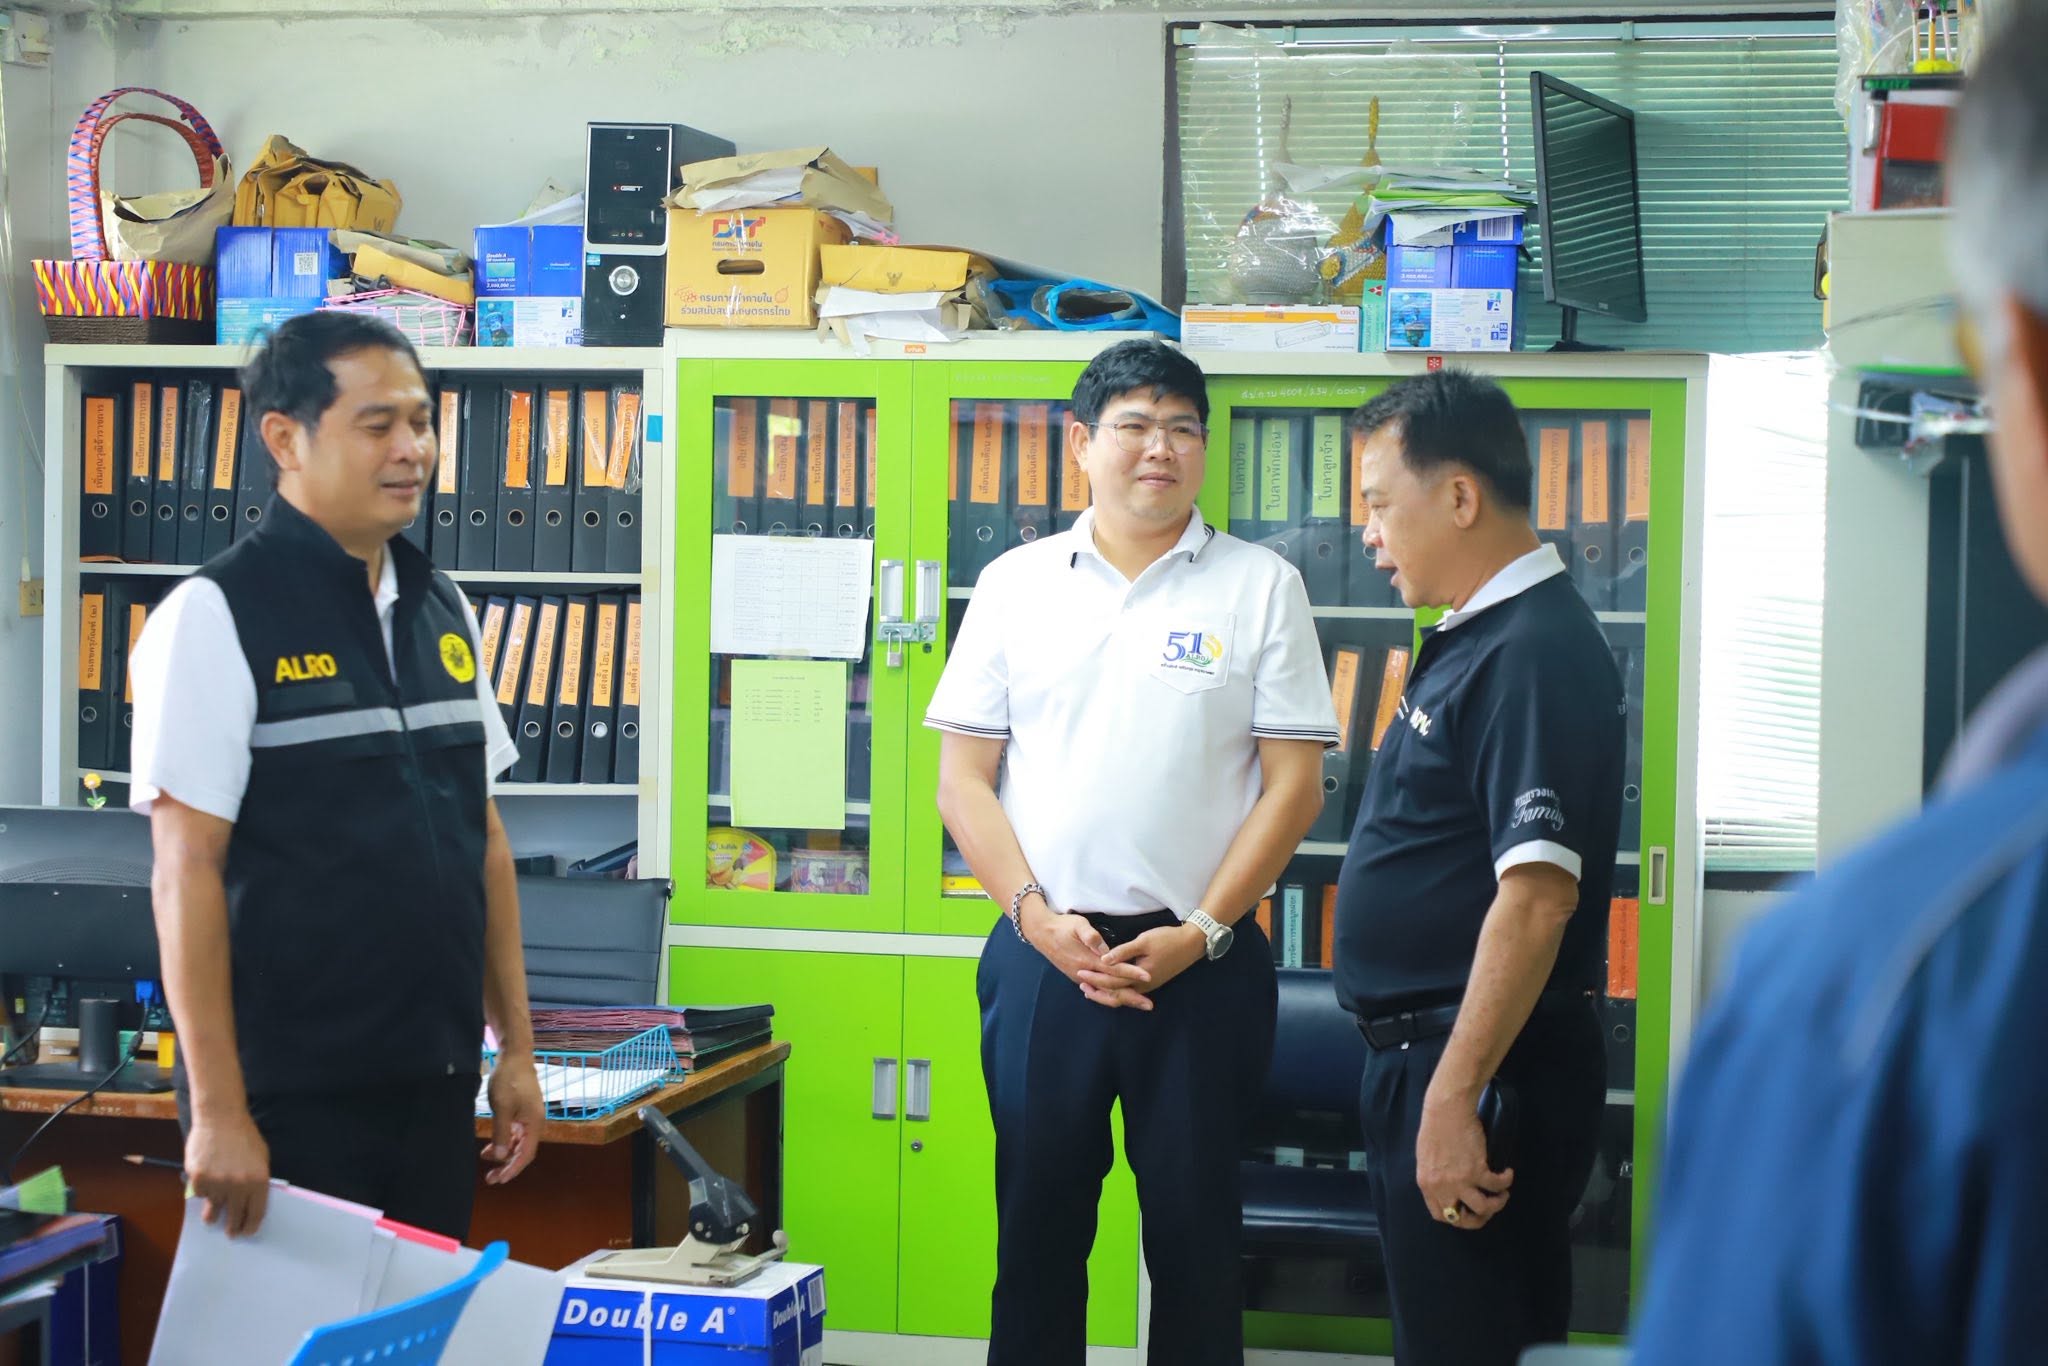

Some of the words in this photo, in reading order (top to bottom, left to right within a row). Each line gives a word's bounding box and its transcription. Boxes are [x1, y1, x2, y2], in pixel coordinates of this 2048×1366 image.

[1266, 431, 1281, 511] ใบลาพักผ่อน
[1318, 433, 1337, 501] ใบลาลูกจ้าง
[1163, 631, 1203, 661] 51
[275, 653, 338, 683] ALRO
[1512, 800, 1565, 831] Family
[562, 1298, 690, 1333] Double
[700, 1306, 726, 1334] A
